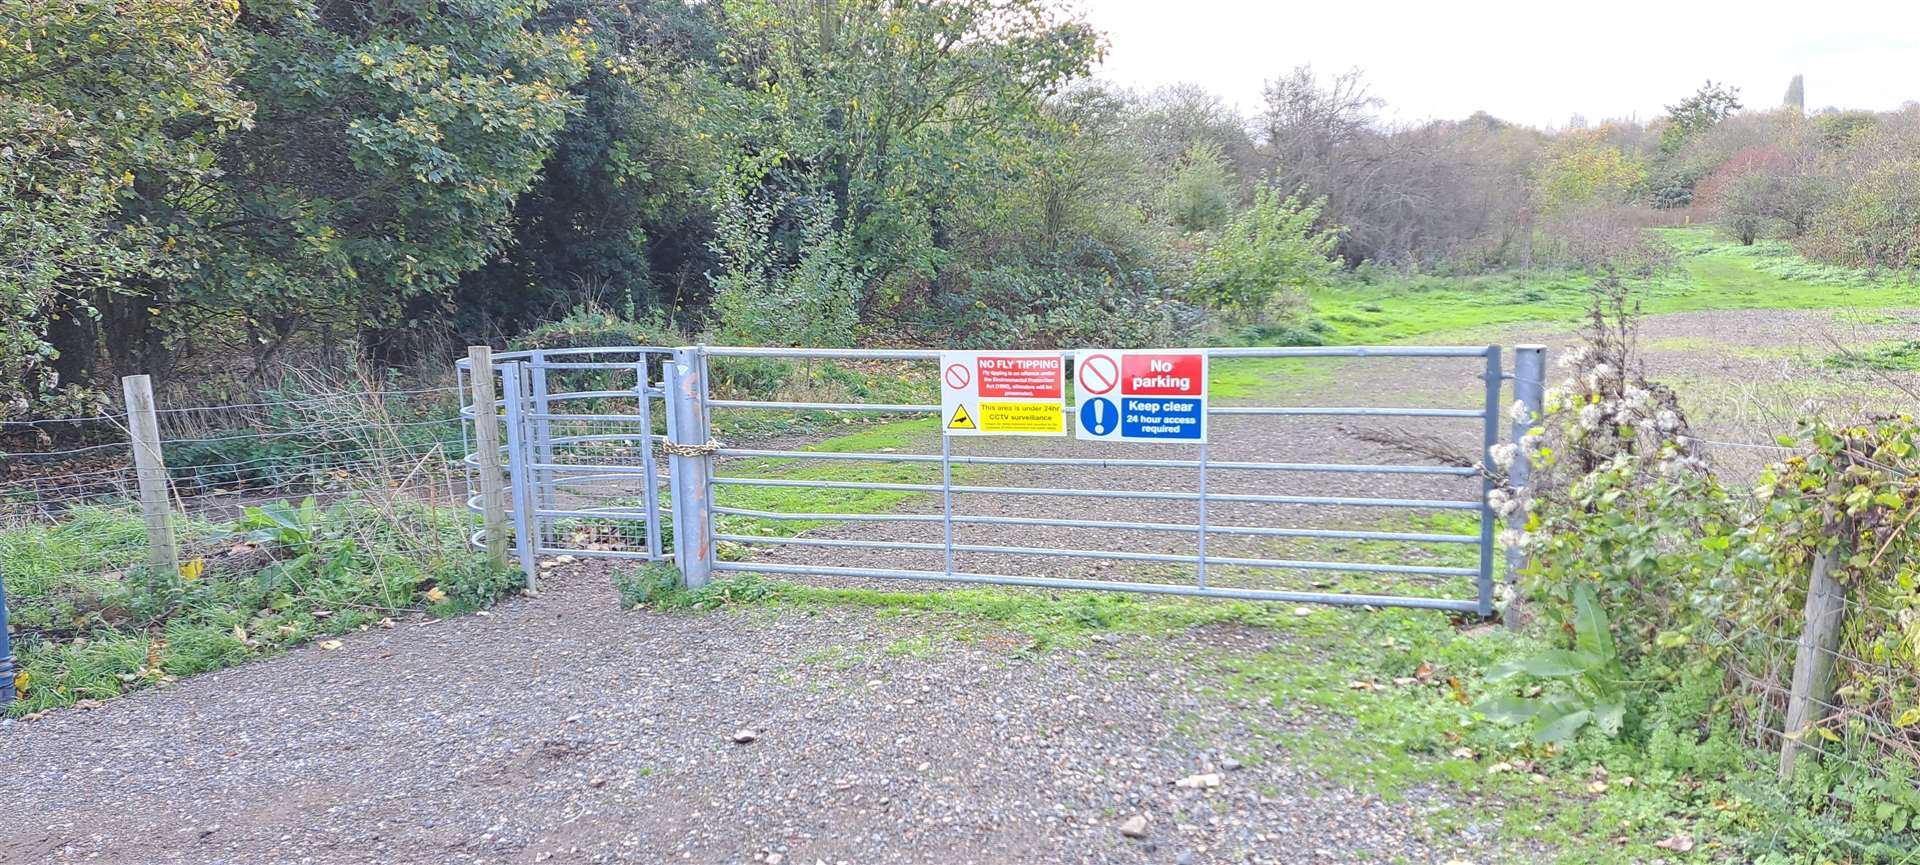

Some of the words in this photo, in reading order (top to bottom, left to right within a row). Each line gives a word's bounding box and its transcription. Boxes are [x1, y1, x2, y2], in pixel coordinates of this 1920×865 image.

[979, 360, 995, 369] NO
[997, 360, 1014, 369] FLY
[1016, 360, 1058, 369] TIPPING
[1151, 360, 1172, 372] No
[1133, 375, 1190, 391] parking
[1129, 400, 1160, 414] Keep
[1163, 401, 1194, 412] clear
[1140, 415, 1162, 423] hour
[1142, 425, 1180, 434] required
